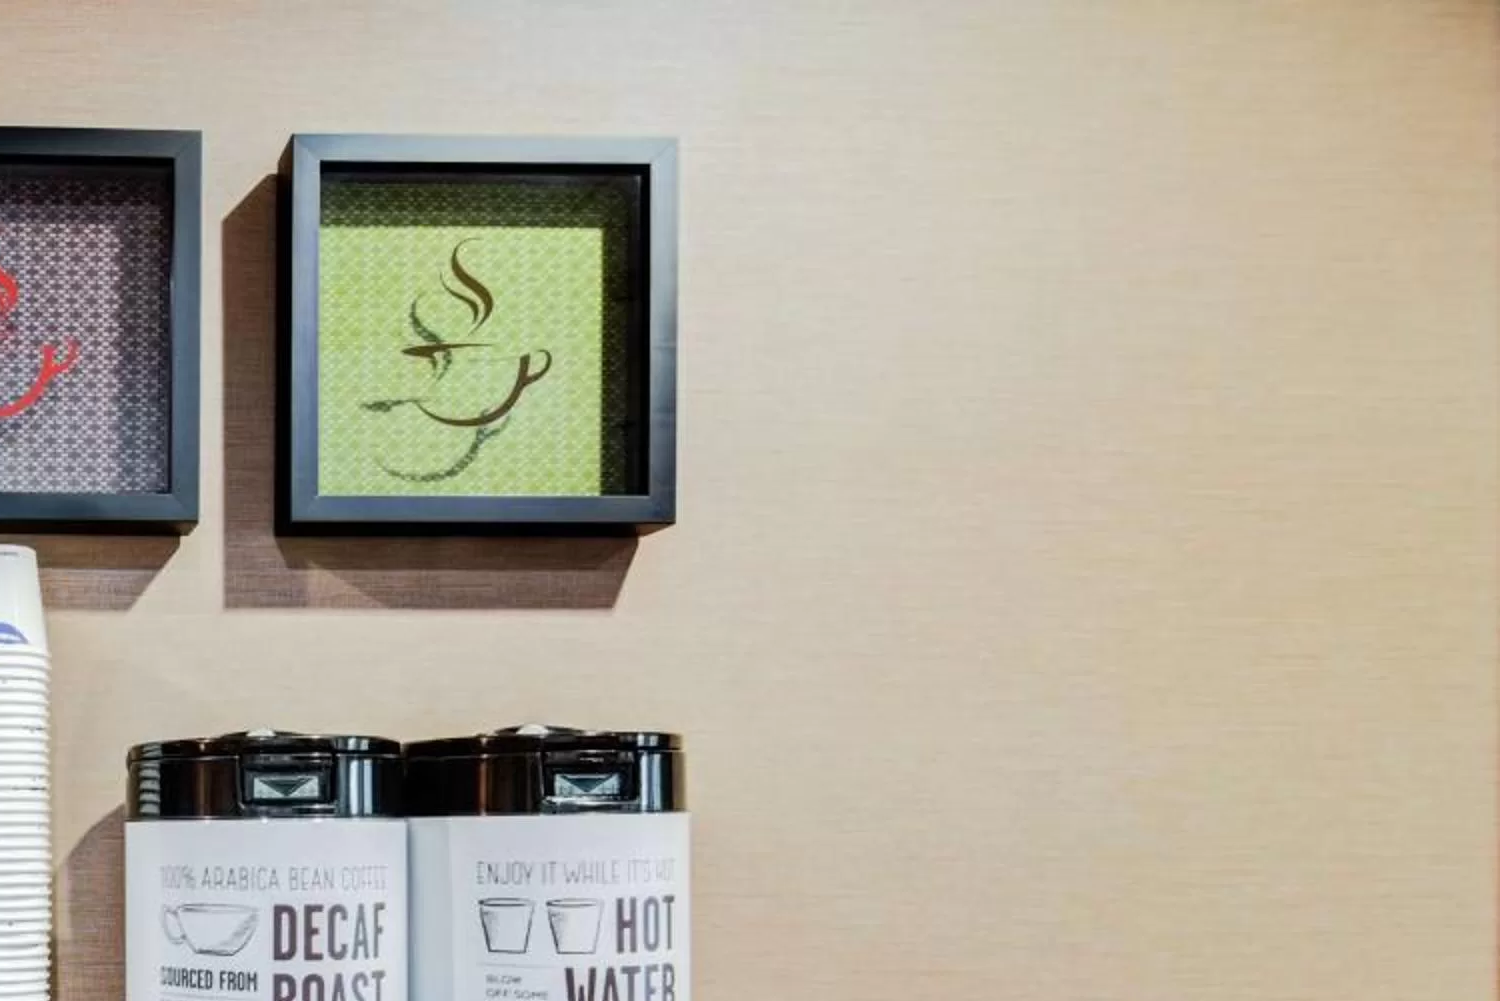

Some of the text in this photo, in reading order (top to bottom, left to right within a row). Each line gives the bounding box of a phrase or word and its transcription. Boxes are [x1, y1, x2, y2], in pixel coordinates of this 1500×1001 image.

[201, 866, 280, 892] ARABICA
[288, 866, 334, 892] BEAN
[476, 860, 533, 886] ENJOY
[542, 860, 557, 885] IT
[563, 860, 621, 885] WHILE
[272, 902, 386, 960] DECAF
[615, 895, 675, 955] HOT
[160, 966, 258, 992] SOURCED FROM
